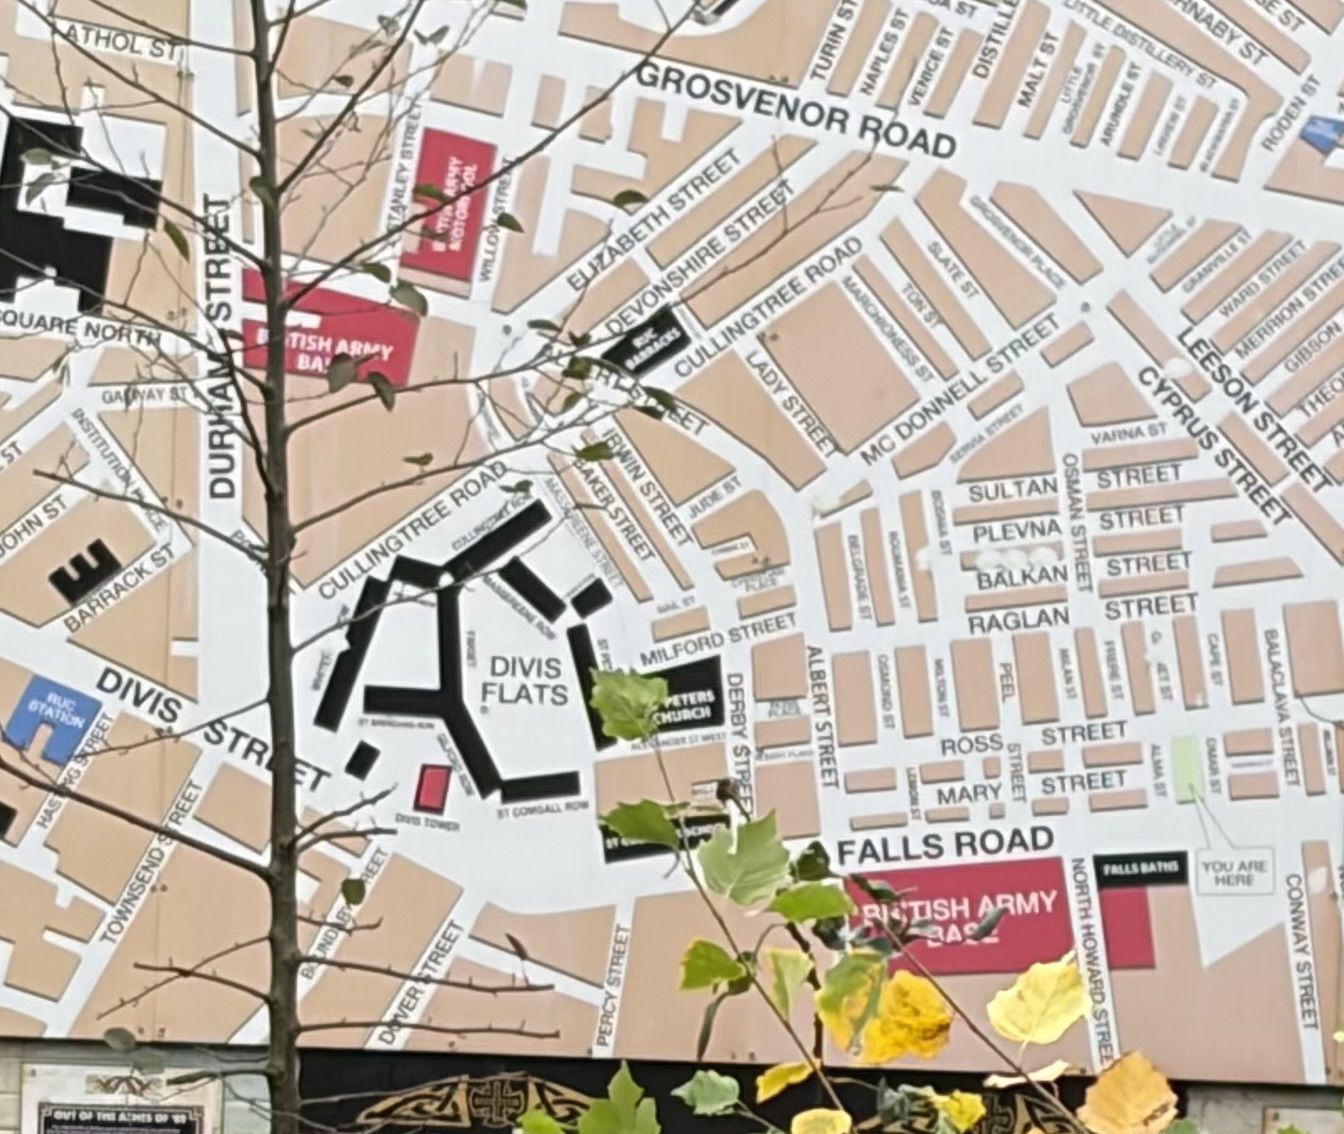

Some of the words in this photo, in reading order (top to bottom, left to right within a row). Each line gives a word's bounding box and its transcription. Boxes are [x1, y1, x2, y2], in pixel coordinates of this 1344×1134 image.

[65, 27, 145, 56] ATHOL
[148, 40, 178, 61] ST
[1017, 56, 1049, 109] MALT
[1039, 30, 1060, 56] ST
[635, 62, 851, 134] GROSVENOR
[859, 108, 957, 160] ROAD
[566, 208, 670, 293] ELIZABETH
[666, 146, 742, 216] STREET
[203, 193, 233, 323] STREET
[605, 235, 726, 337] DEVONSHIRE
[723, 177, 797, 247] STREET
[1218, 281, 1261, 319] WARD
[1257, 238, 1307, 284] STREET
[83, 317, 163, 349] NORTH
[673, 281, 805, 379] CULLINGTREE
[802, 236, 865, 288] ROAD
[1234, 300, 1305, 361] MERRION
[1284, 320, 1343, 374] GIBSON
[745, 352, 786, 399] LADY
[782, 393, 838, 459] STREET
[859, 433, 896, 467] MC
[900, 373, 987, 439] DONNELL
[985, 312, 1060, 376] STREET
[1177, 325, 1261, 413] LEESON
[1254, 408, 1333, 494] STREET
[208, 350, 236, 500] DURHAM
[1138, 365, 1220, 450] CYPRUS
[1214, 443, 1294, 528] STREET
[968, 477, 1058, 502] SULTAN
[1096, 463, 1182, 489] STREET
[1062, 453, 1085, 523] OSMAN
[318, 498, 453, 602] CULLINGTREE
[451, 460, 509, 510] ROAD
[973, 519, 1063, 543] PLEVNA
[1099, 505, 1185, 530] STREET
[1069, 524, 1094, 594] STREET
[63, 563, 154, 635] BARRACK
[152, 542, 177, 571] ST
[976, 565, 1068, 591] BALKAN
[1107, 551, 1192, 576] STREET
[640, 632, 725, 667] MILFORD
[728, 612, 798, 643] STREET
[968, 607, 1070, 635] RAGLAN
[1105, 593, 1199, 620] STREET
[481, 682, 569, 706] FLATS
[490, 655, 562, 679] DIVIS
[807, 644, 833, 717] ALBERT
[1000, 661, 1018, 703] PEEL
[28, 699, 86, 731] STATION
[95, 666, 184, 724] DIVIS
[203, 718, 332, 792] STRET
[726, 673, 748, 740] DERBY
[941, 734, 1004, 756] ROSS
[1042, 720, 1129, 746] STREET
[1264, 628, 1289, 724] BALACLAVA
[1278, 725, 1302, 788] STREET
[815, 719, 840, 790] STREET
[937, 783, 1002, 807] MARY
[1042, 770, 1128, 796] STREET
[1007, 742, 1028, 803] STREET
[98, 844, 166, 945] TOWNSEND
[156, 779, 203, 846] SREET
[837, 833, 944, 866] FALLS
[955, 825, 1055, 857] ROAD
[1202, 860, 1236, 874] YOU
[1239, 860, 1268, 873] ARE
[1214, 873, 1255, 887] HERE
[977, 890, 1058, 918] ARMY
[1071, 858, 1093, 921] NORTH
[1082, 921, 1106, 1005] HOWARD
[1285, 873, 1311, 961] CONWAY
[606, 924, 632, 984] STREET
[596, 984, 623, 1048] PERCY
[1296, 961, 1319, 1031] STREET
